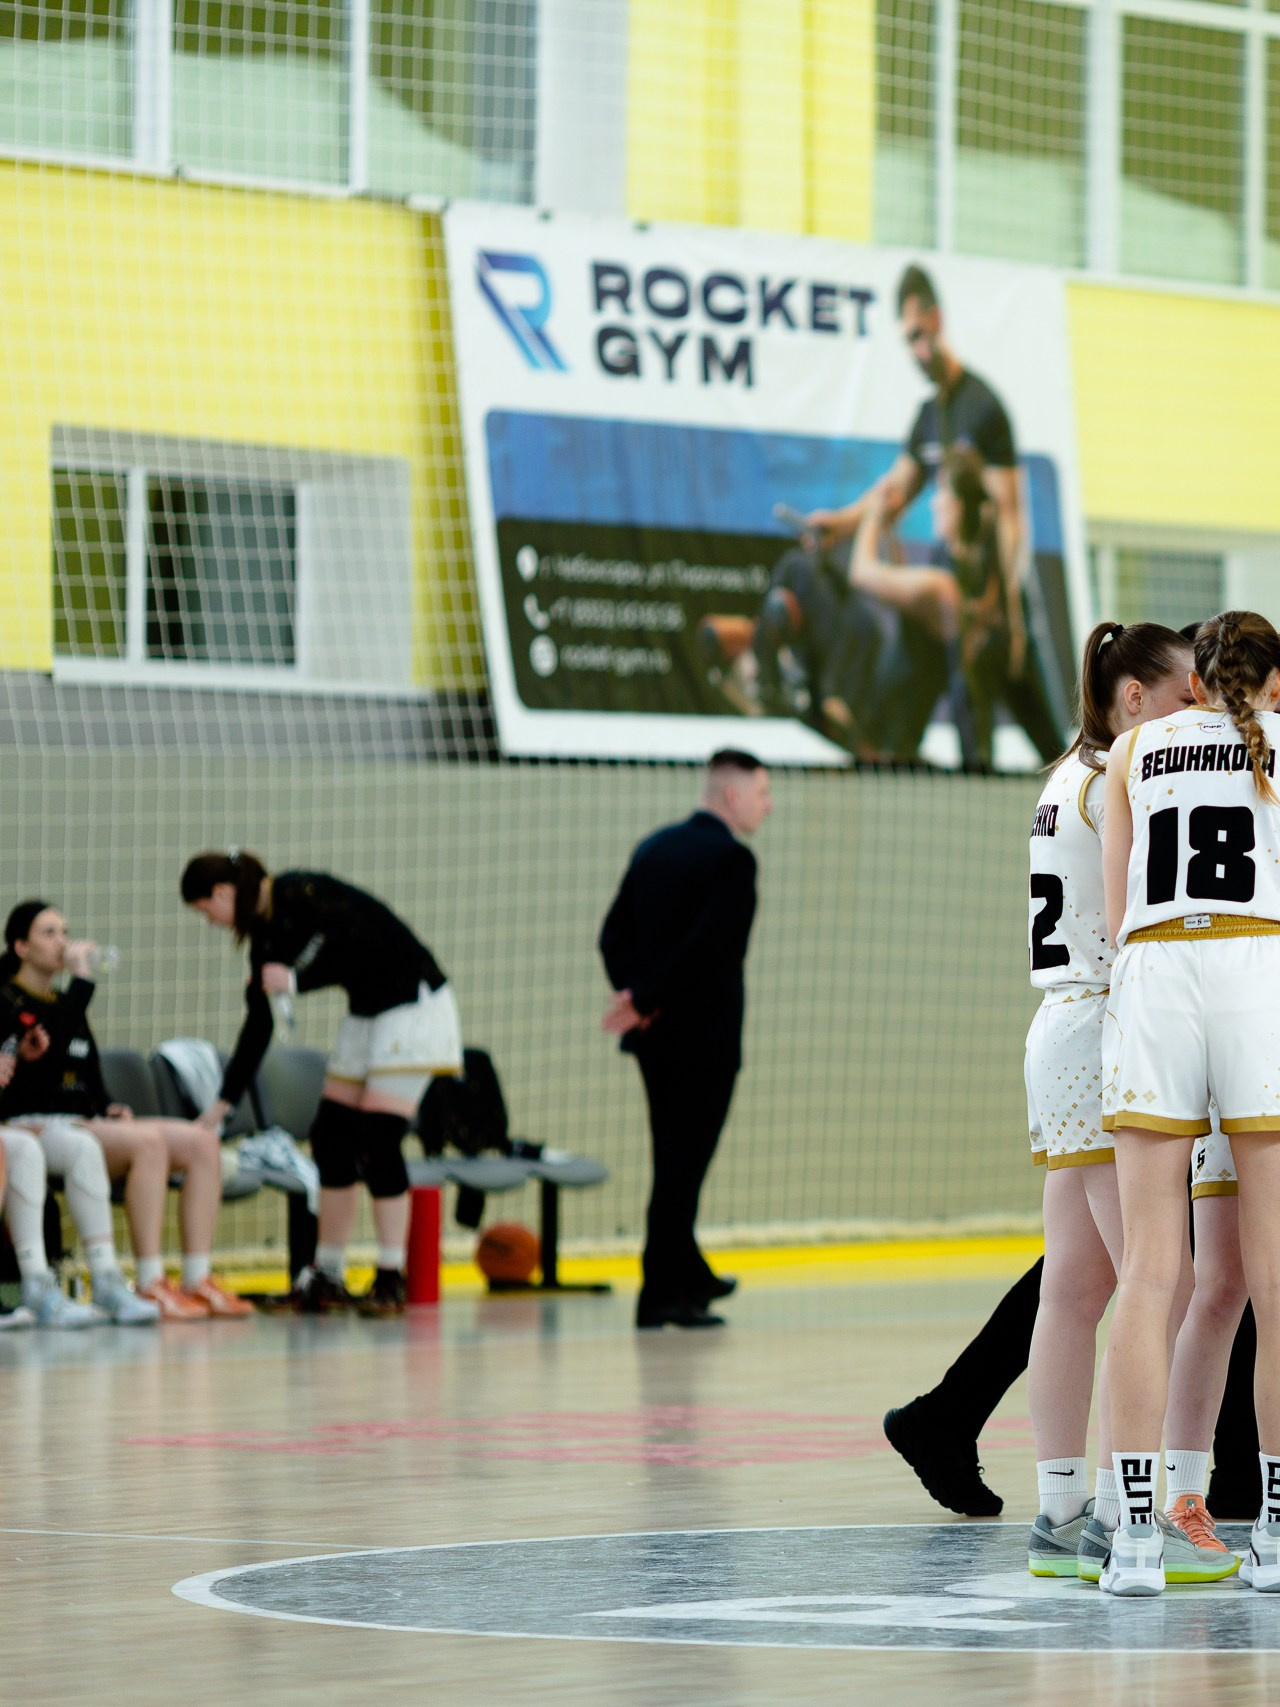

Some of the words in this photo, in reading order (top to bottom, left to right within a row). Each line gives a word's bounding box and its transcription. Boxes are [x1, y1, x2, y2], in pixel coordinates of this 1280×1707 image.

[591, 261, 876, 337] ROCKET
[596, 325, 756, 389] GYM
[1147, 805, 1256, 905] 18
